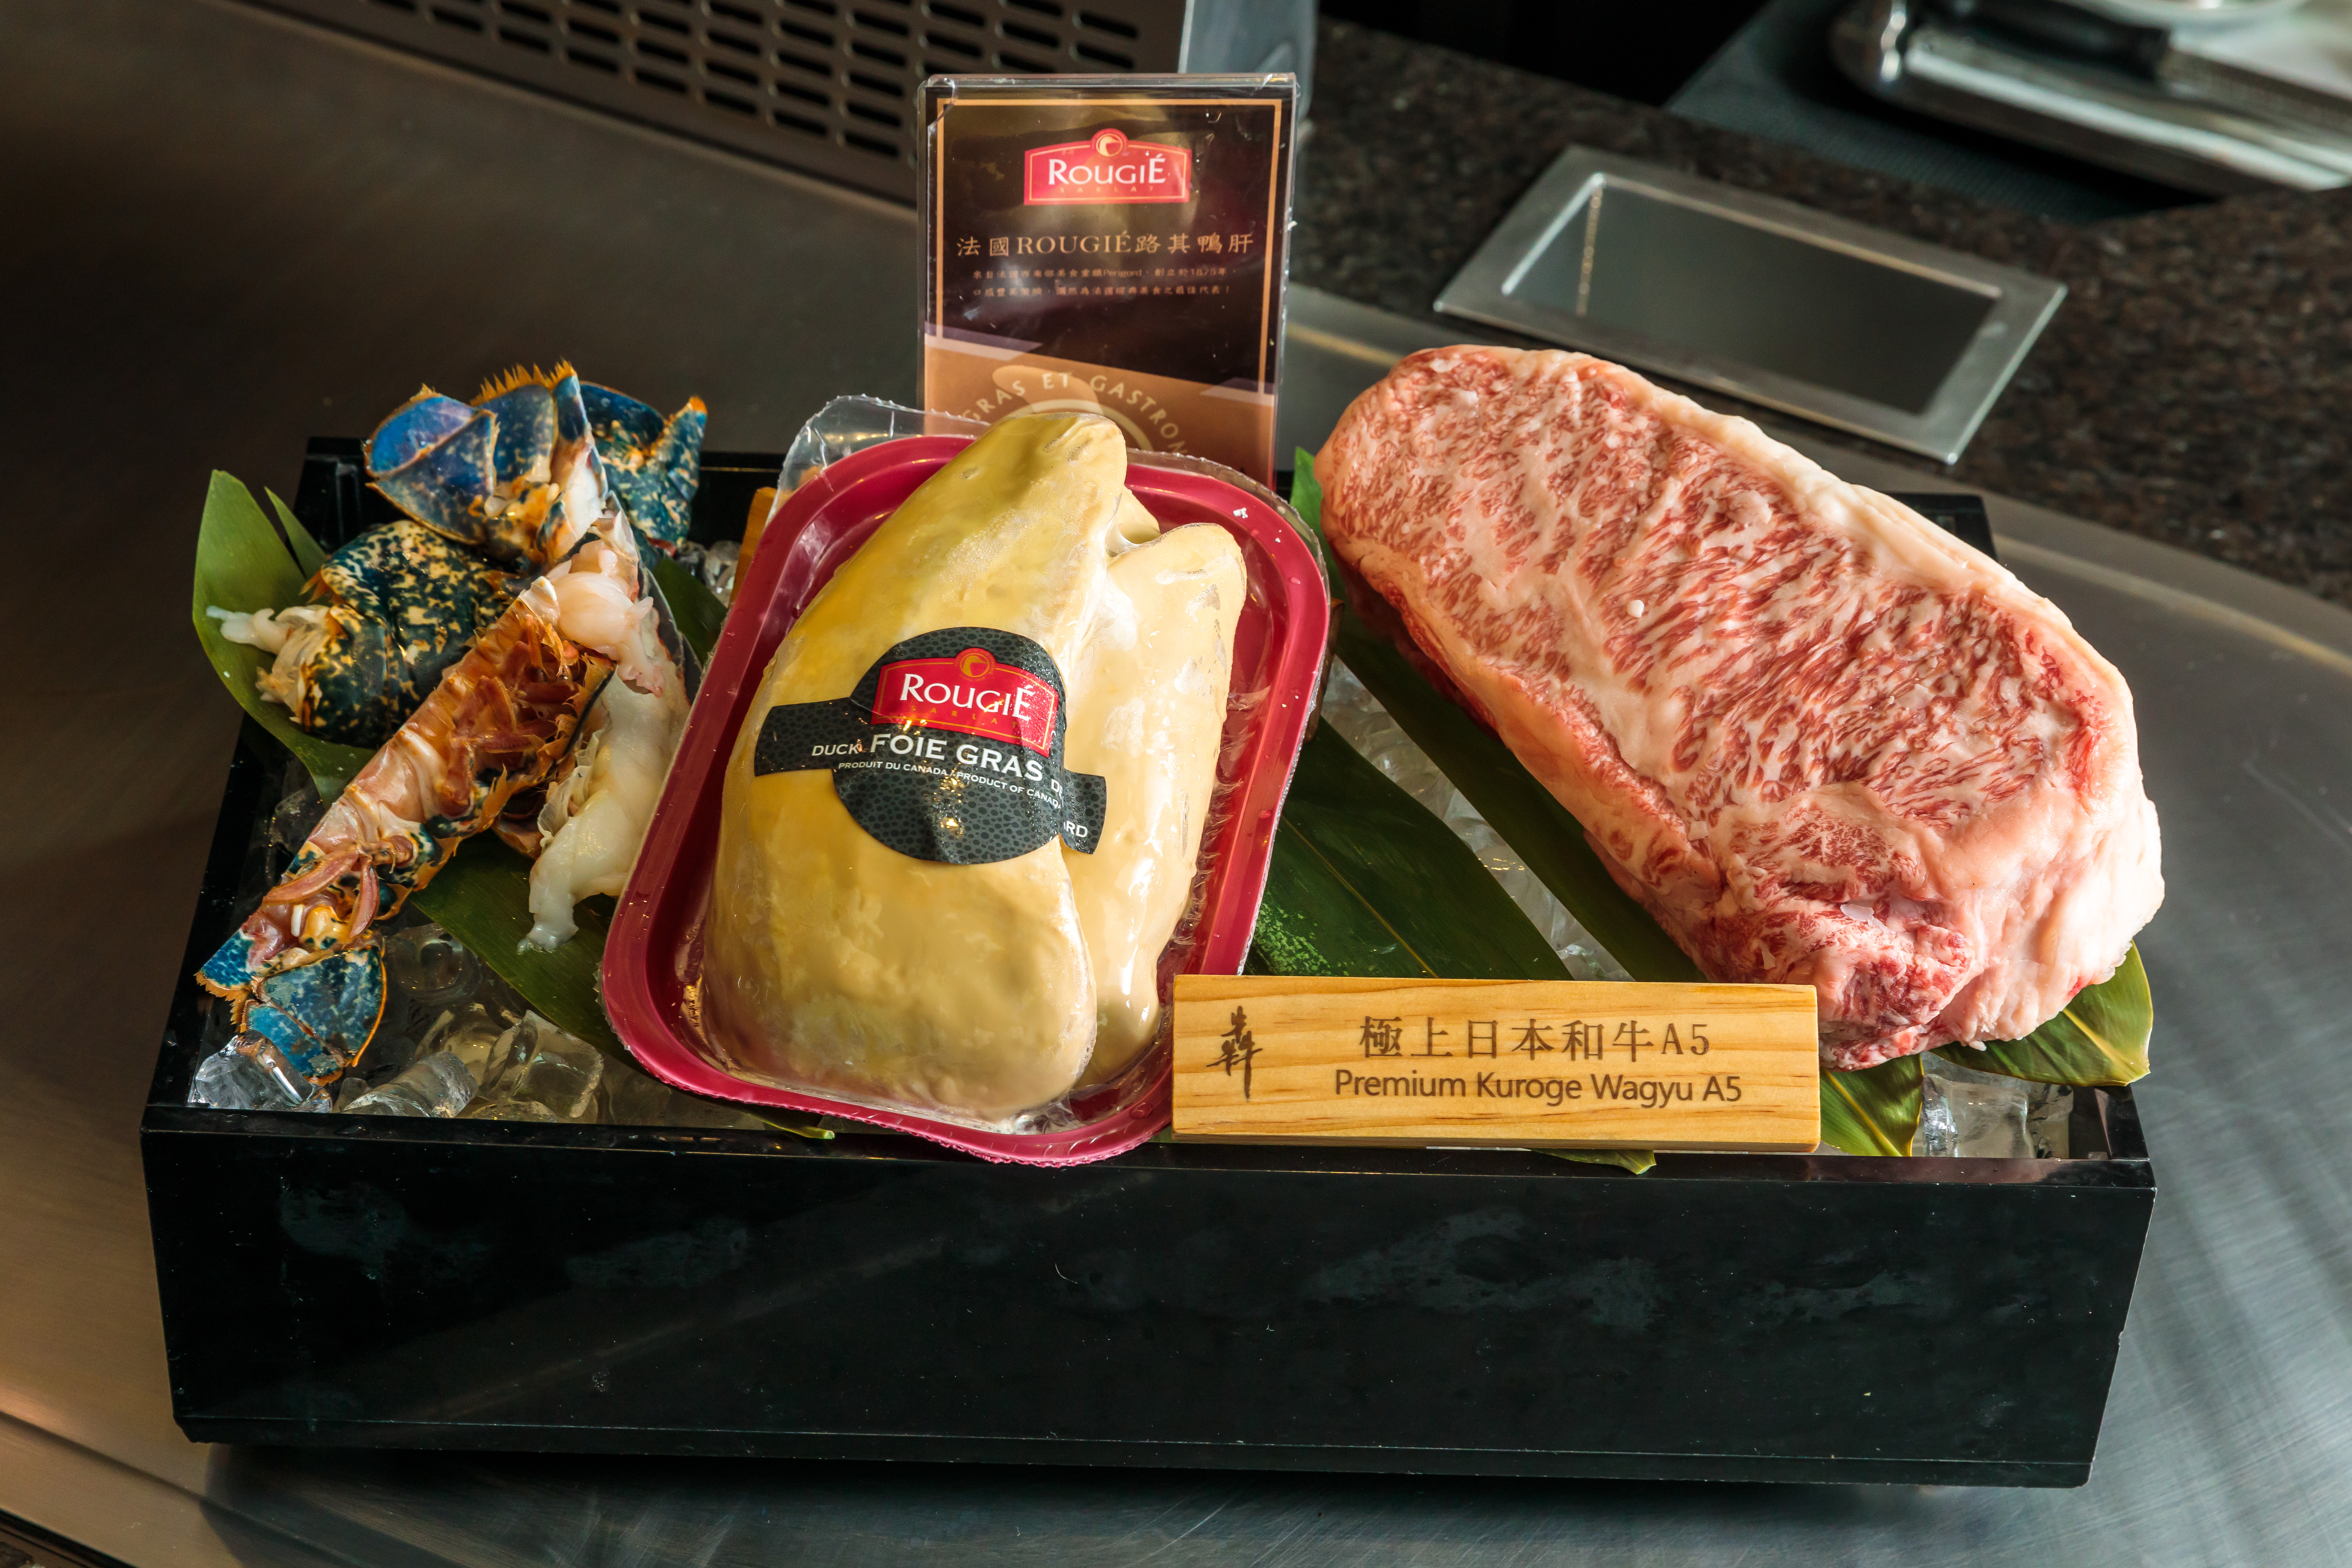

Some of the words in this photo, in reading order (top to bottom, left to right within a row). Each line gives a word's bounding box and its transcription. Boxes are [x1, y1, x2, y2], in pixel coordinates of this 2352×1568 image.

[962, 379, 1026, 421] GRAS
[1042, 372, 1073, 390] ET
[911, 705, 1016, 728] SARLAT
[812, 743, 859, 756] DUCK
[870, 733, 948, 760] FOIE
[956, 744, 1042, 781] GRAS
[838, 761, 883, 769] PRODUIT
[903, 764, 948, 776] CANADA
[956, 771, 1008, 790] PRODUCT
[1009, 785, 1025, 793] OF
[1336, 1069, 1466, 1097] Premium
[1477, 1072, 1581, 1107] Kuroge
[1590, 1074, 1693, 1109] Wagyu
[1702, 1076, 1742, 1102] A5
